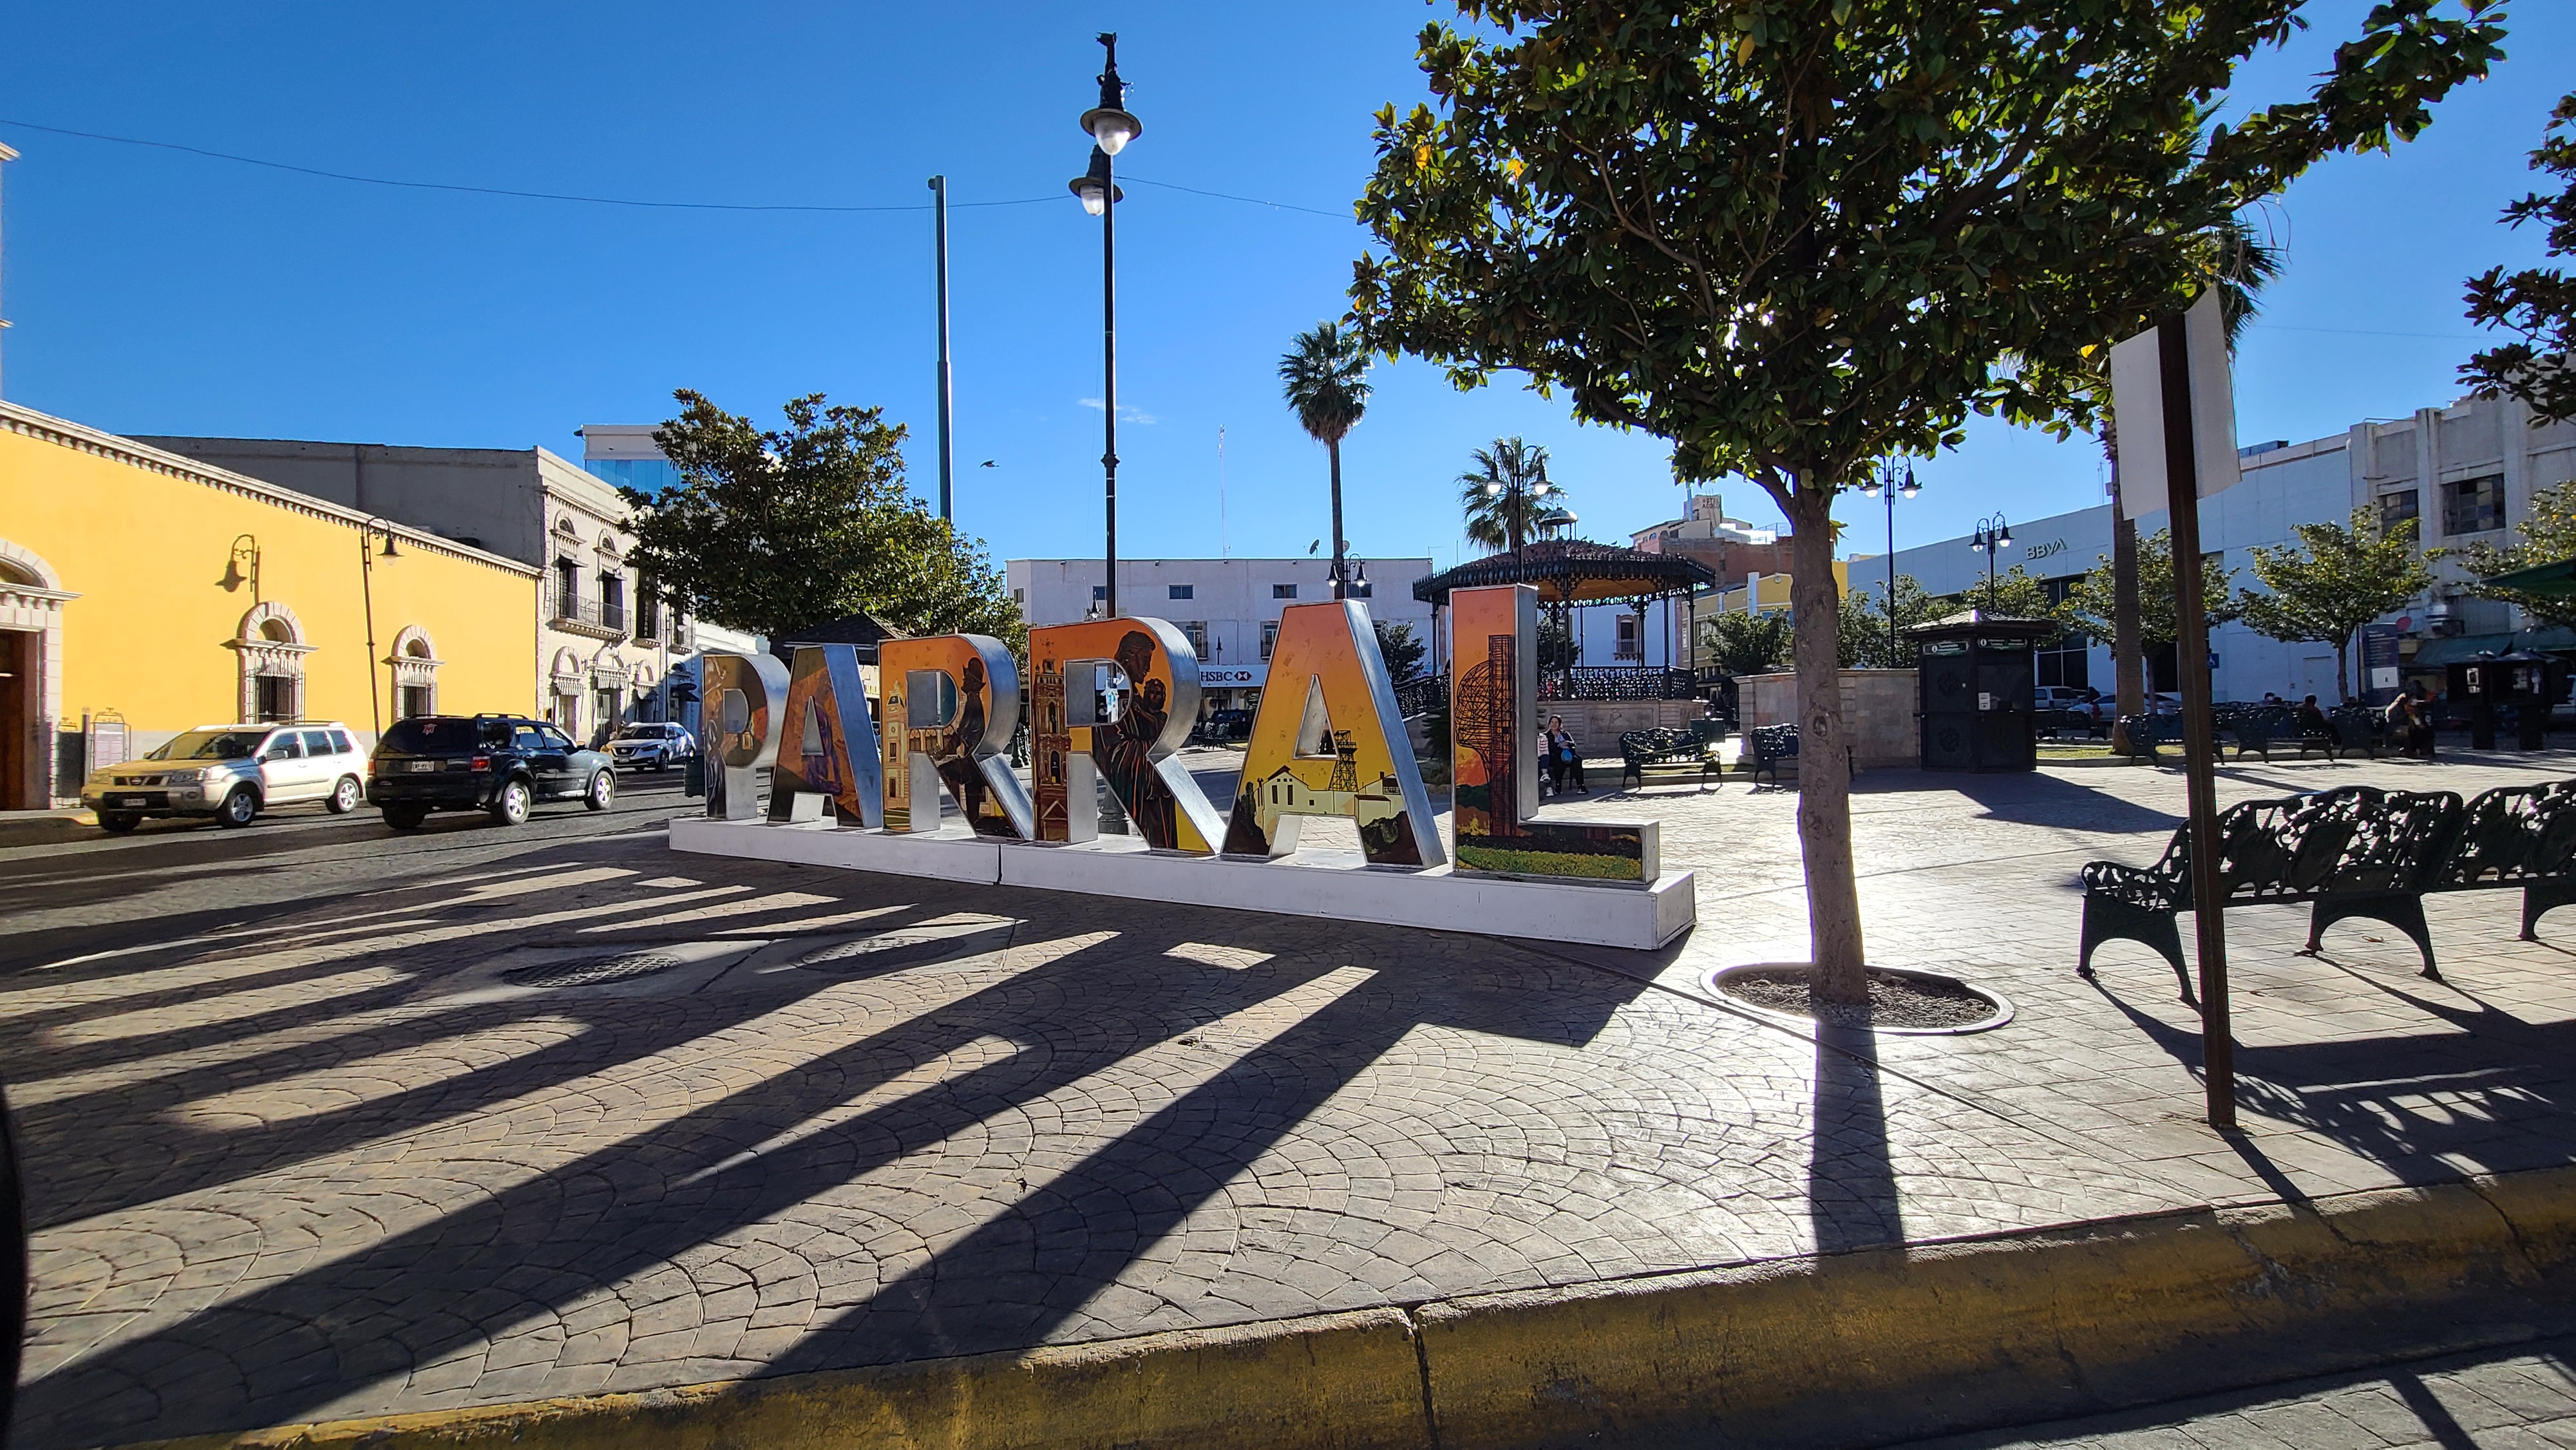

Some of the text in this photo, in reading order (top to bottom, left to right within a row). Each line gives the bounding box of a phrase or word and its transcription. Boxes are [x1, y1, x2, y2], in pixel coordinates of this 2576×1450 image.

[2026, 538, 2067, 560] BBVA
[1200, 671, 1233, 681] HSBC
[703, 585, 1660, 884] PARRAL
